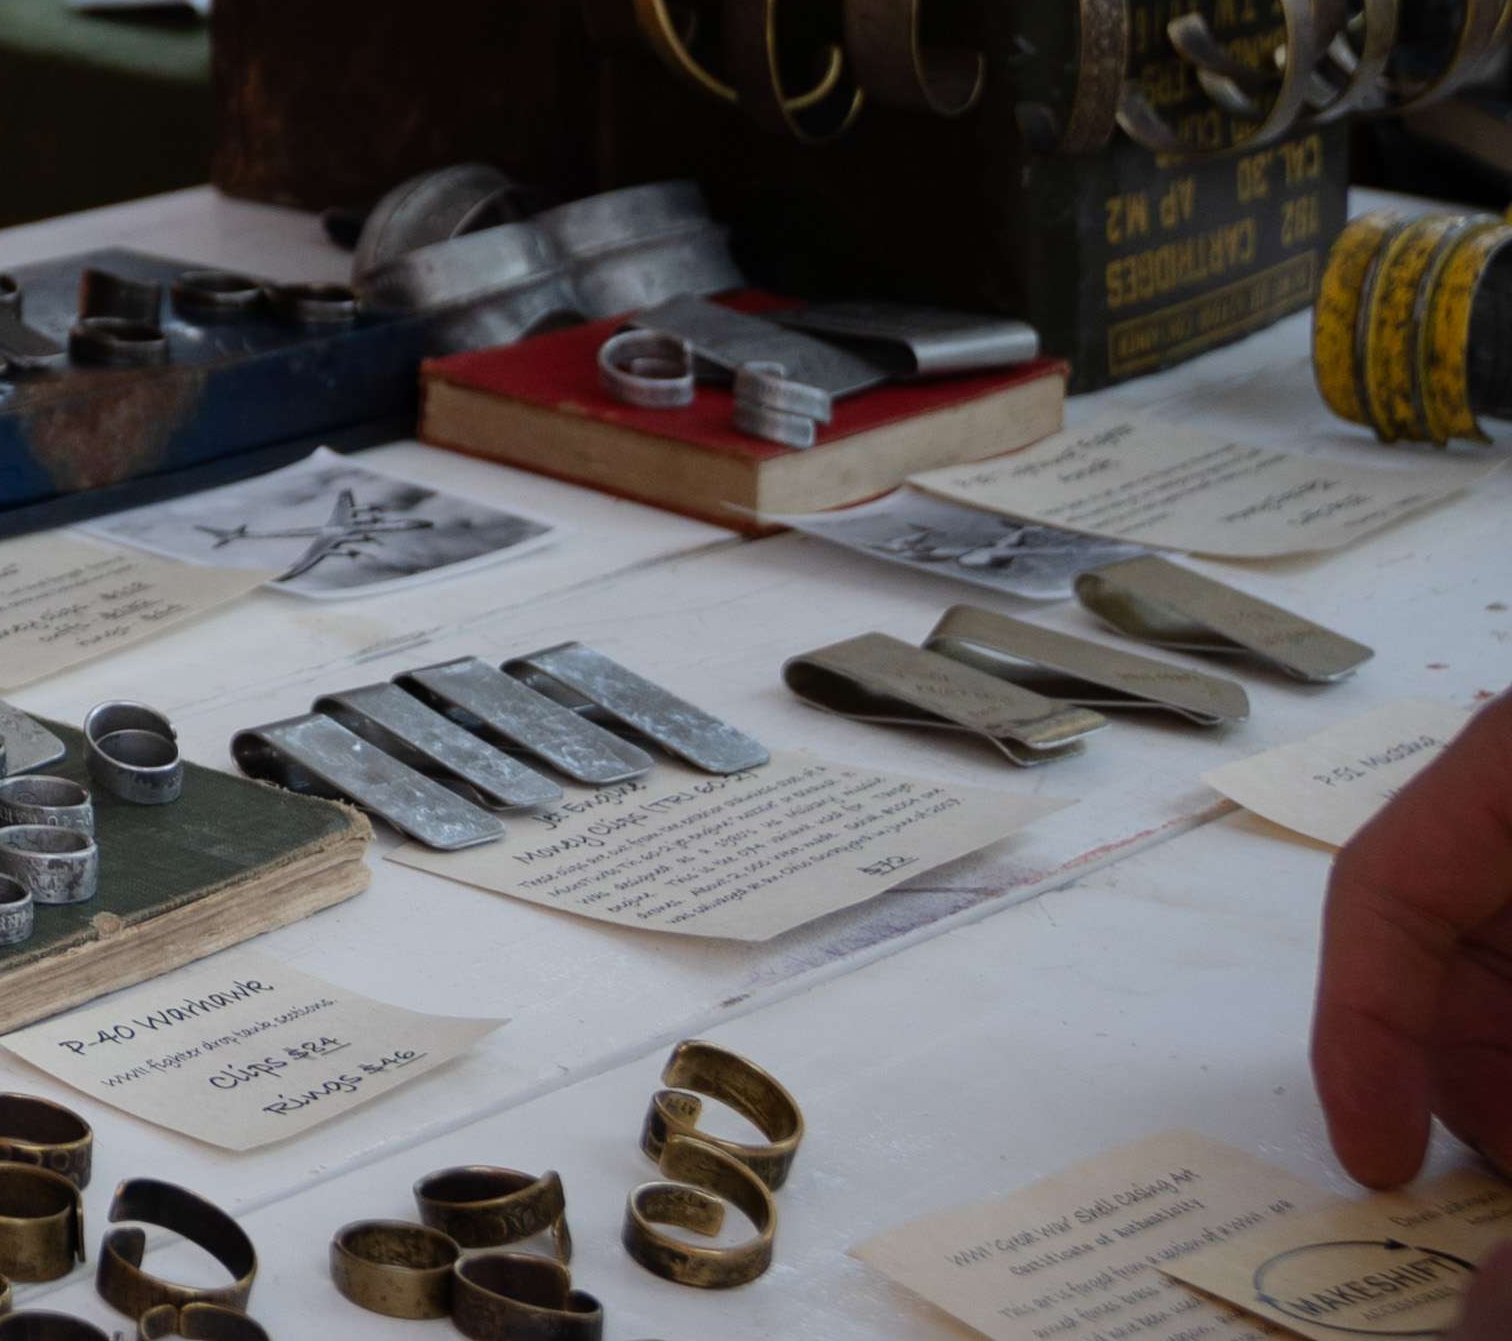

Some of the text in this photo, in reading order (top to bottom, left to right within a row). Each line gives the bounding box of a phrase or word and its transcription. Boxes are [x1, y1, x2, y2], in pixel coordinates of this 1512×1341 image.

[59, 977, 274, 1055] P-40 Warhawk
[146, 1047, 203, 1078] fighter
[203, 1033, 240, 1055] drop
[208, 1056, 288, 1092] Clips
[262, 1071, 363, 1116] Rings
[1288, 1255, 1460, 1317] MAKESHIFT
